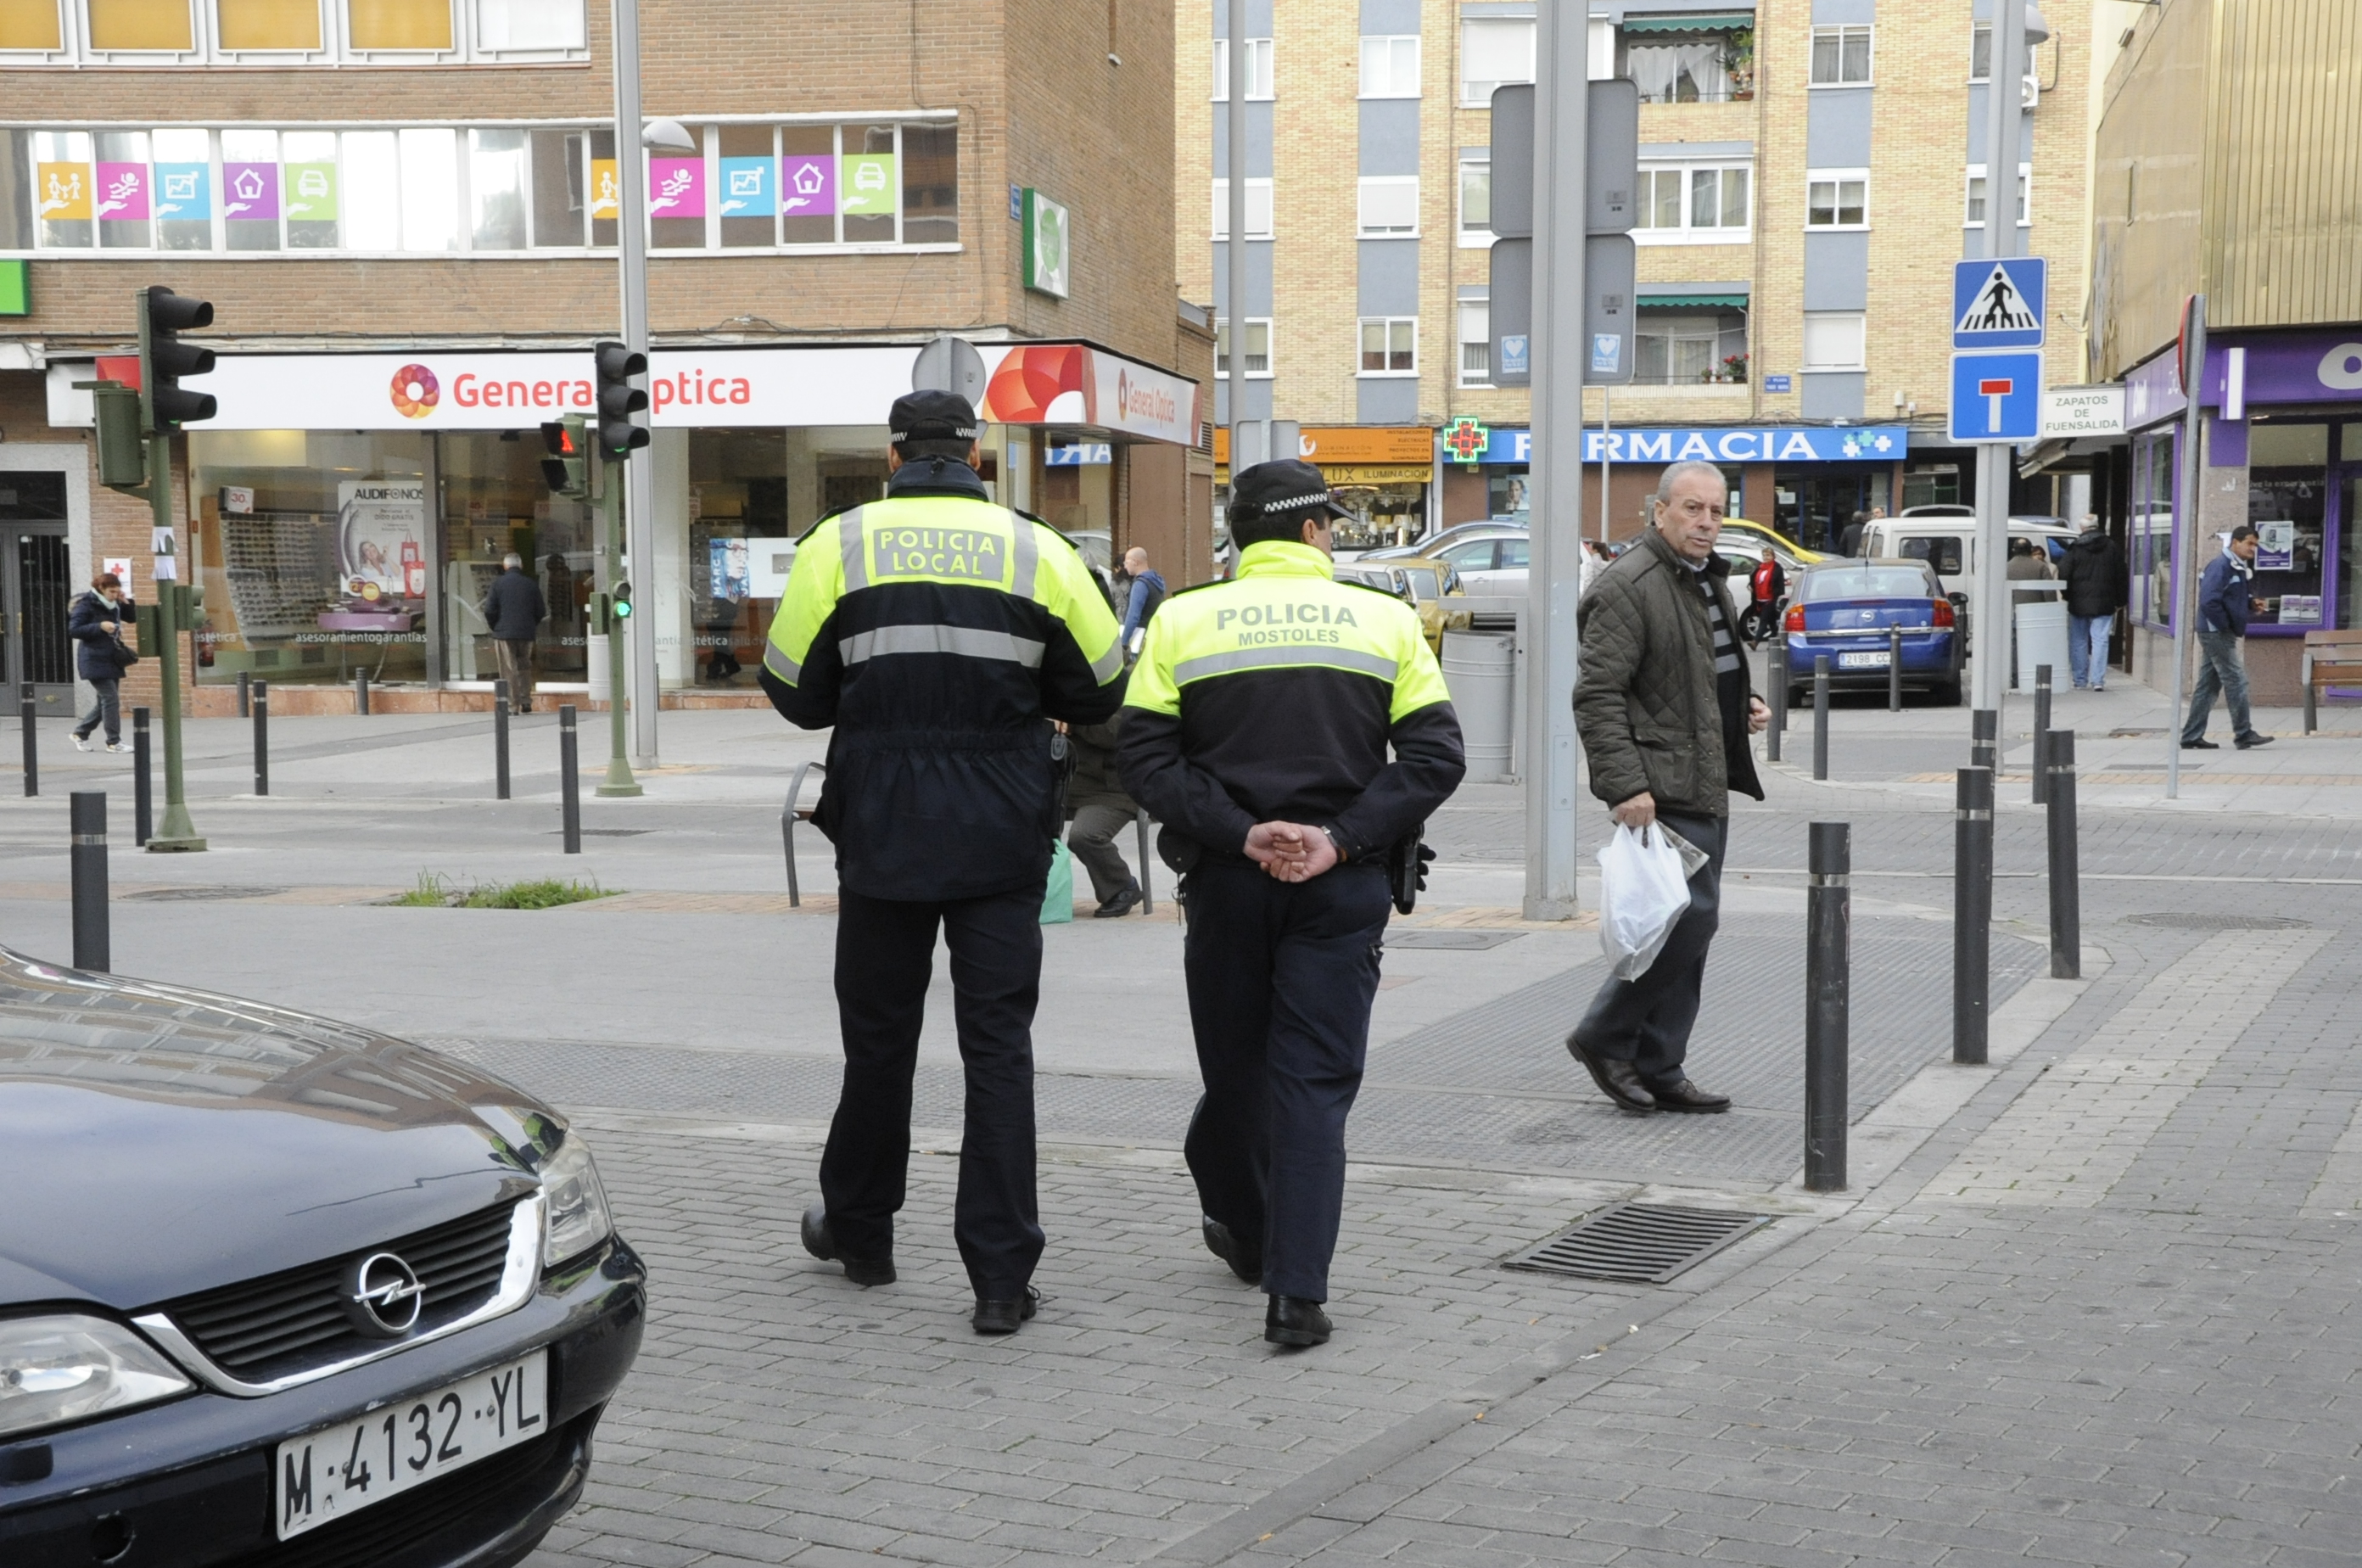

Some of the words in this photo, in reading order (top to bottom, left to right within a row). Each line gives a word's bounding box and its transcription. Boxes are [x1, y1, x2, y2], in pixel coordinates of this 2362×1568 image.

[453, 373, 592, 407] Genera
[652, 369, 751, 414] ptica
[2056, 395, 2108, 406] ZAPATOS
[1129, 380, 1155, 418] General
[1156, 388, 1175, 428] Optica
[2074, 409, 2090, 418] DE
[2046, 420, 2119, 431] FUENSALIDA
[1514, 432, 1820, 461] FRMACIA
[881, 530, 995, 556] POLICIA
[893, 552, 982, 575] LOCAL
[1217, 603, 1357, 630] POLICIA
[1238, 629, 1339, 646] MOSTOLES
[1846, 654, 1870, 664] 2198
[1876, 654, 1889, 663] CC
